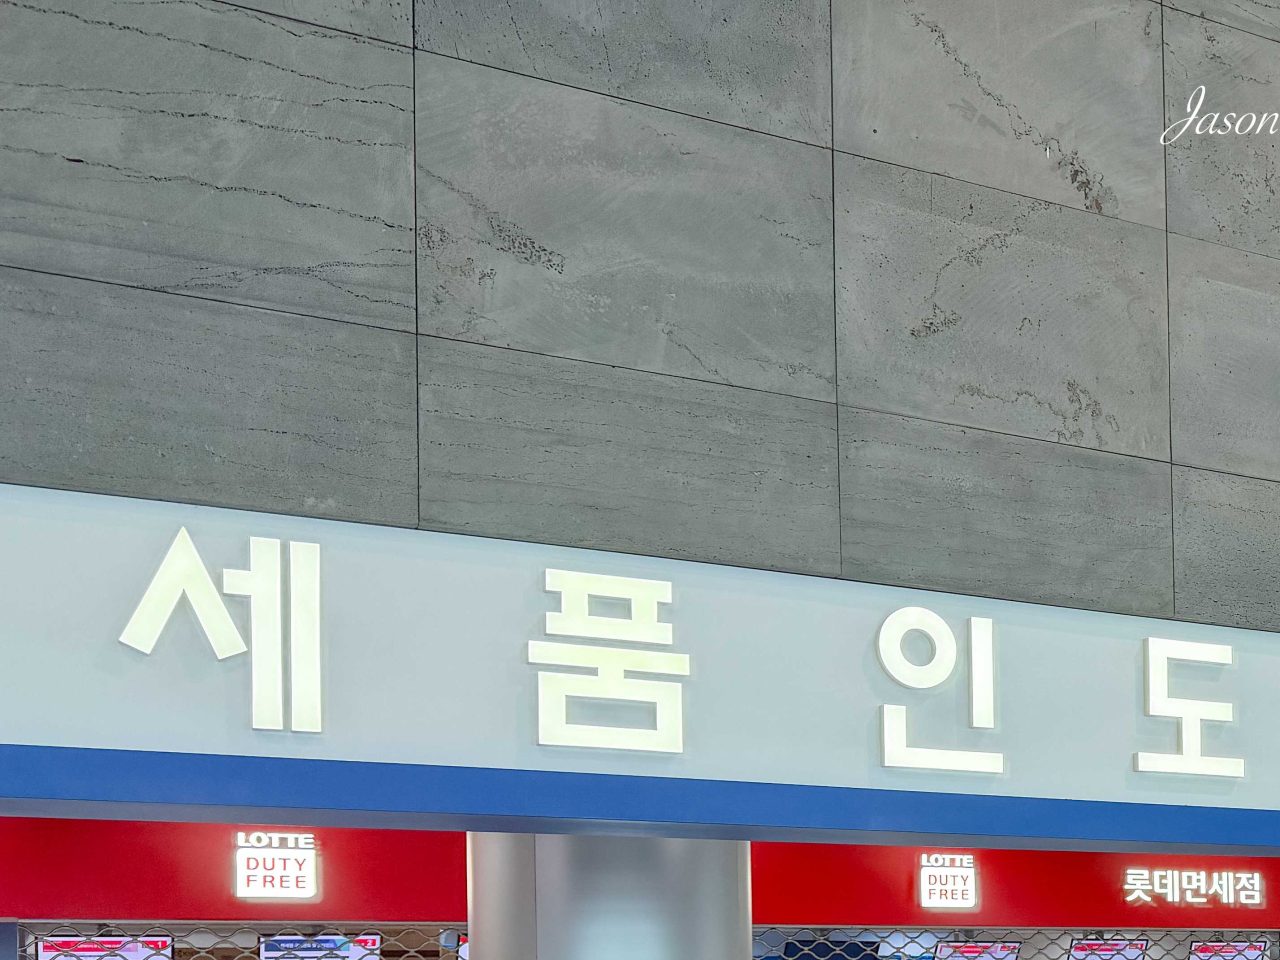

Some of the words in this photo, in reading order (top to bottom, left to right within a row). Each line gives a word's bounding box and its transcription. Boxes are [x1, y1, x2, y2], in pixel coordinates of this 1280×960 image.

[237, 832, 315, 848] LOTTE
[246, 857, 306, 871] DUTY
[921, 854, 974, 867] LOTTE
[246, 874, 306, 888] FREE
[928, 875, 968, 886] DUTY
[1124, 869, 1261, 903] 롯데면세점
[928, 889, 968, 900] FREE
